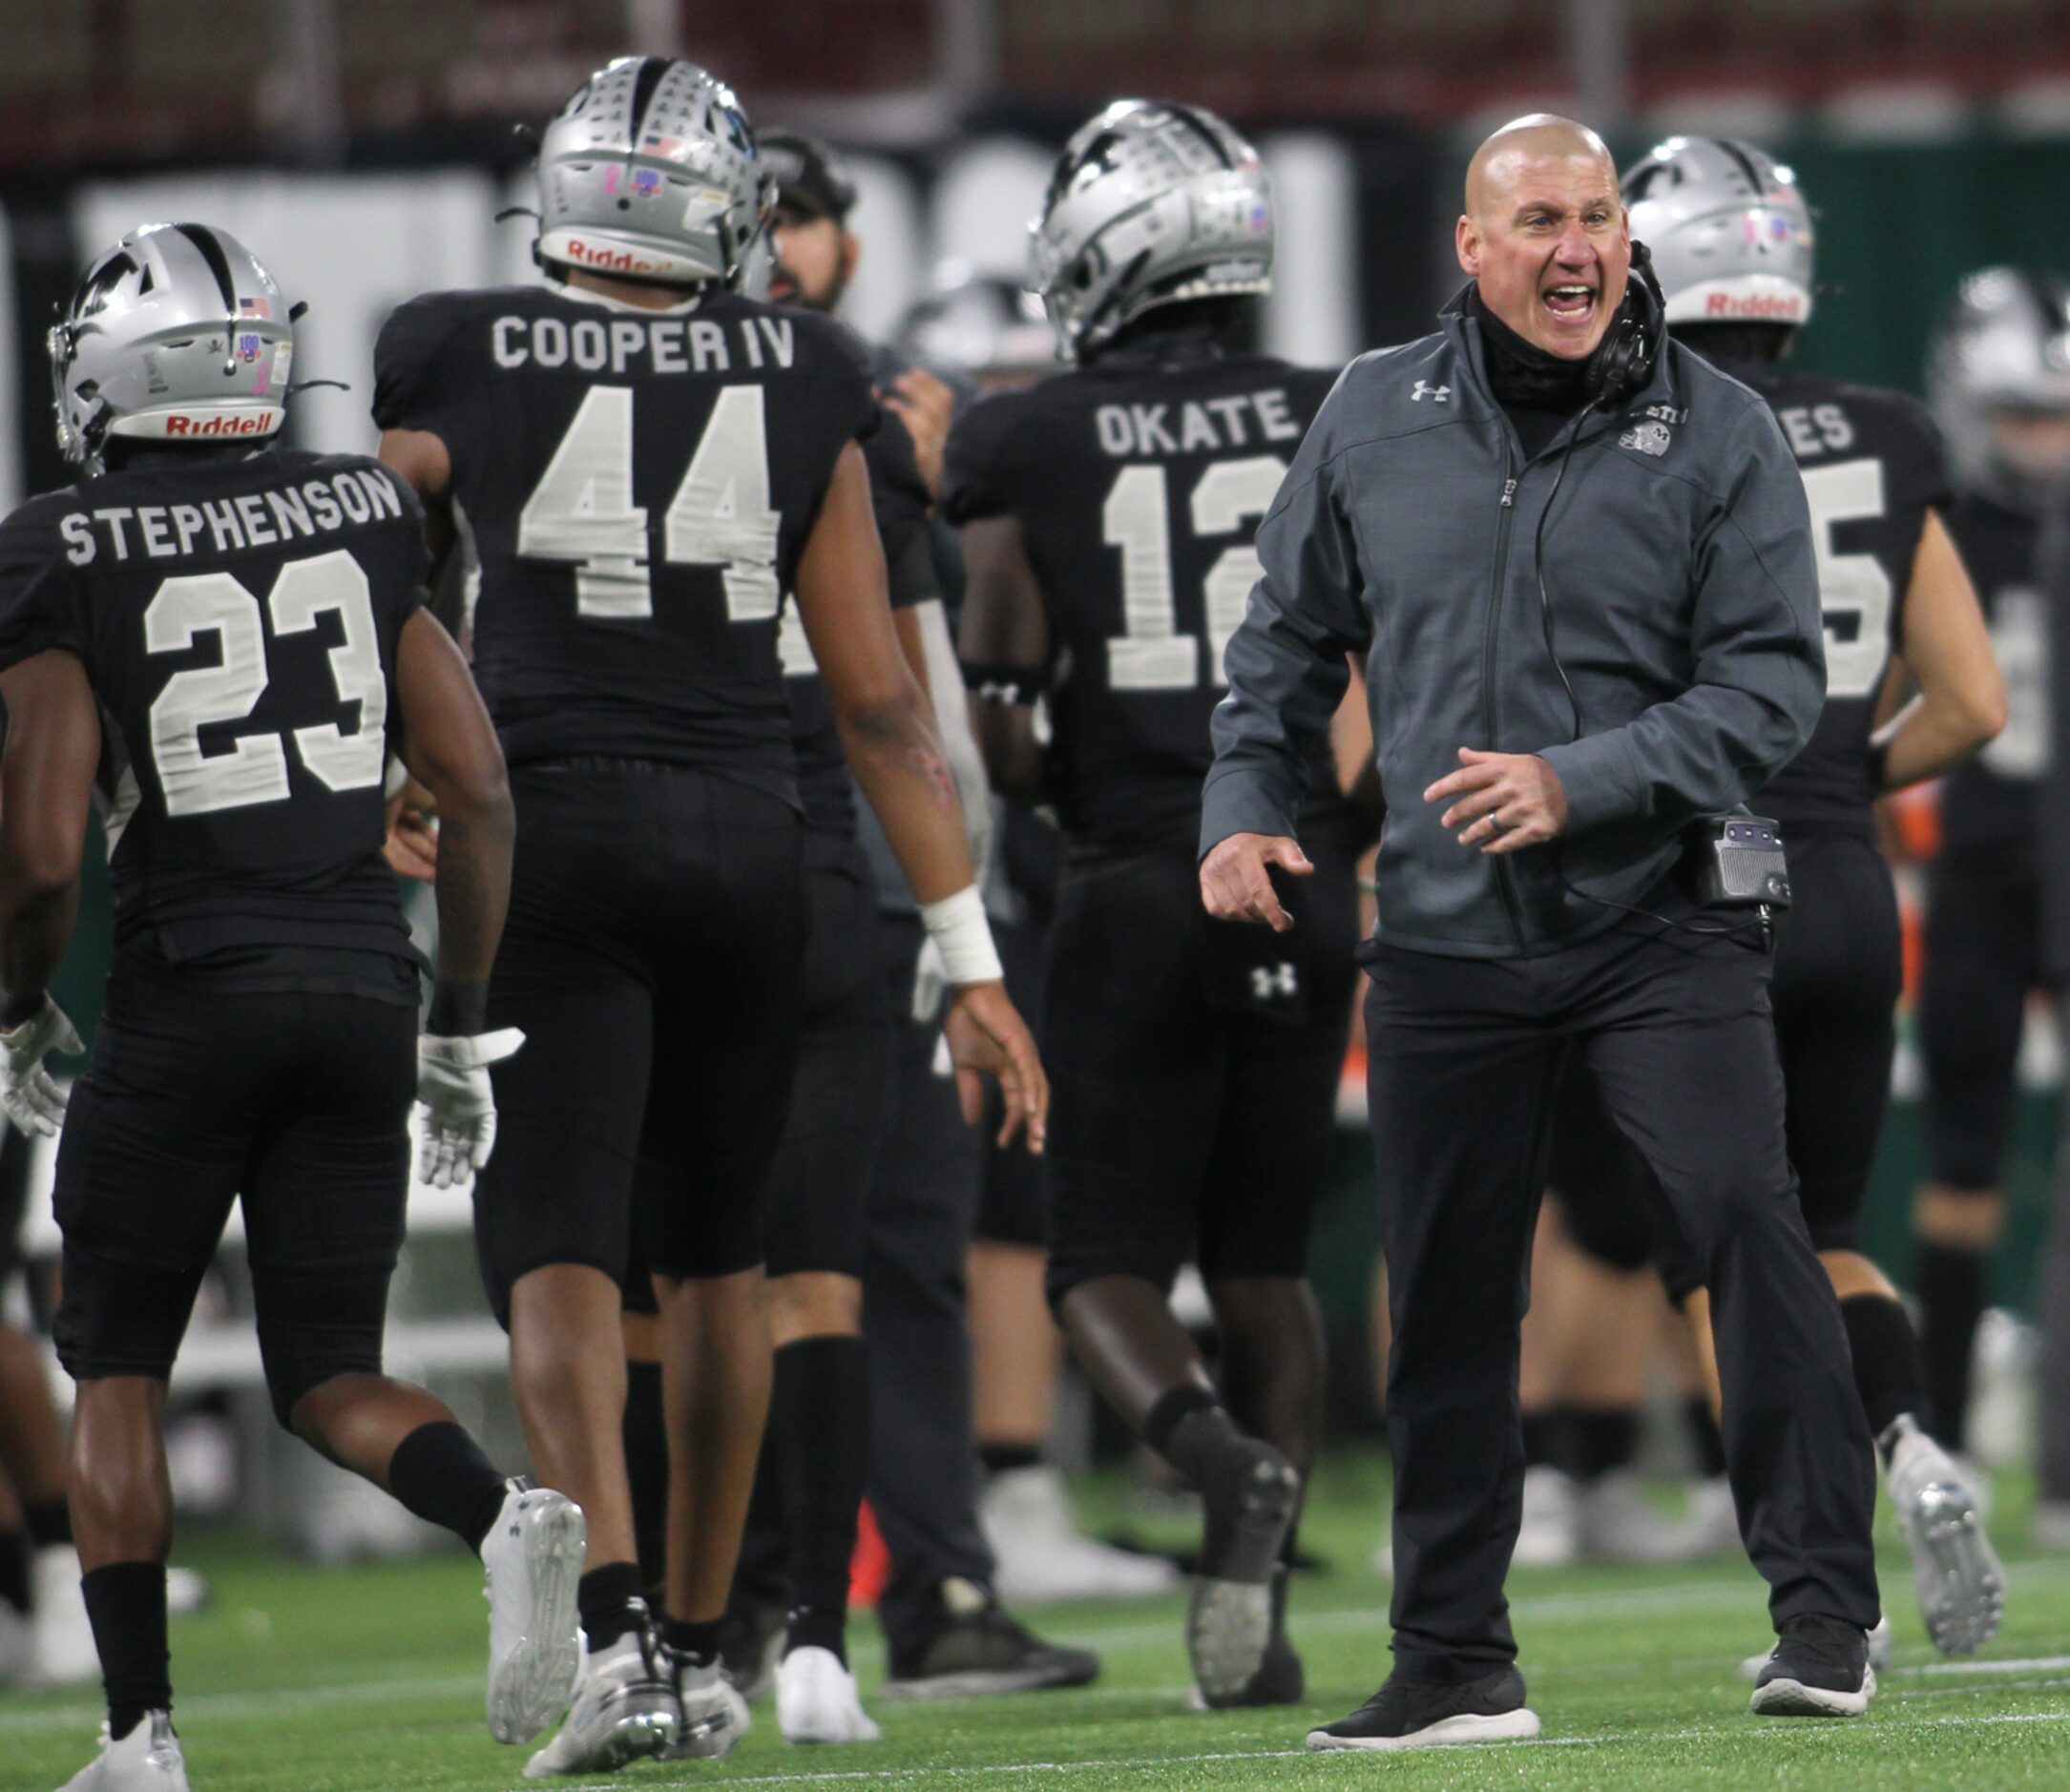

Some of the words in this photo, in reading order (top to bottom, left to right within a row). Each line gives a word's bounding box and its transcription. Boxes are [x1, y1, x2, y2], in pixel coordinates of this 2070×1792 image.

[165, 412, 273, 436] Riddell
[492, 316, 730, 373] COOPER
[742, 316, 794, 369] IV
[1097, 387, 1300, 456] OKATE
[60, 469, 403, 567] STEPHENSON
[516, 384, 782, 624] 44
[1102, 453, 1289, 691] 12
[1801, 458, 1892, 698] 5
[143, 548, 388, 818] 23
